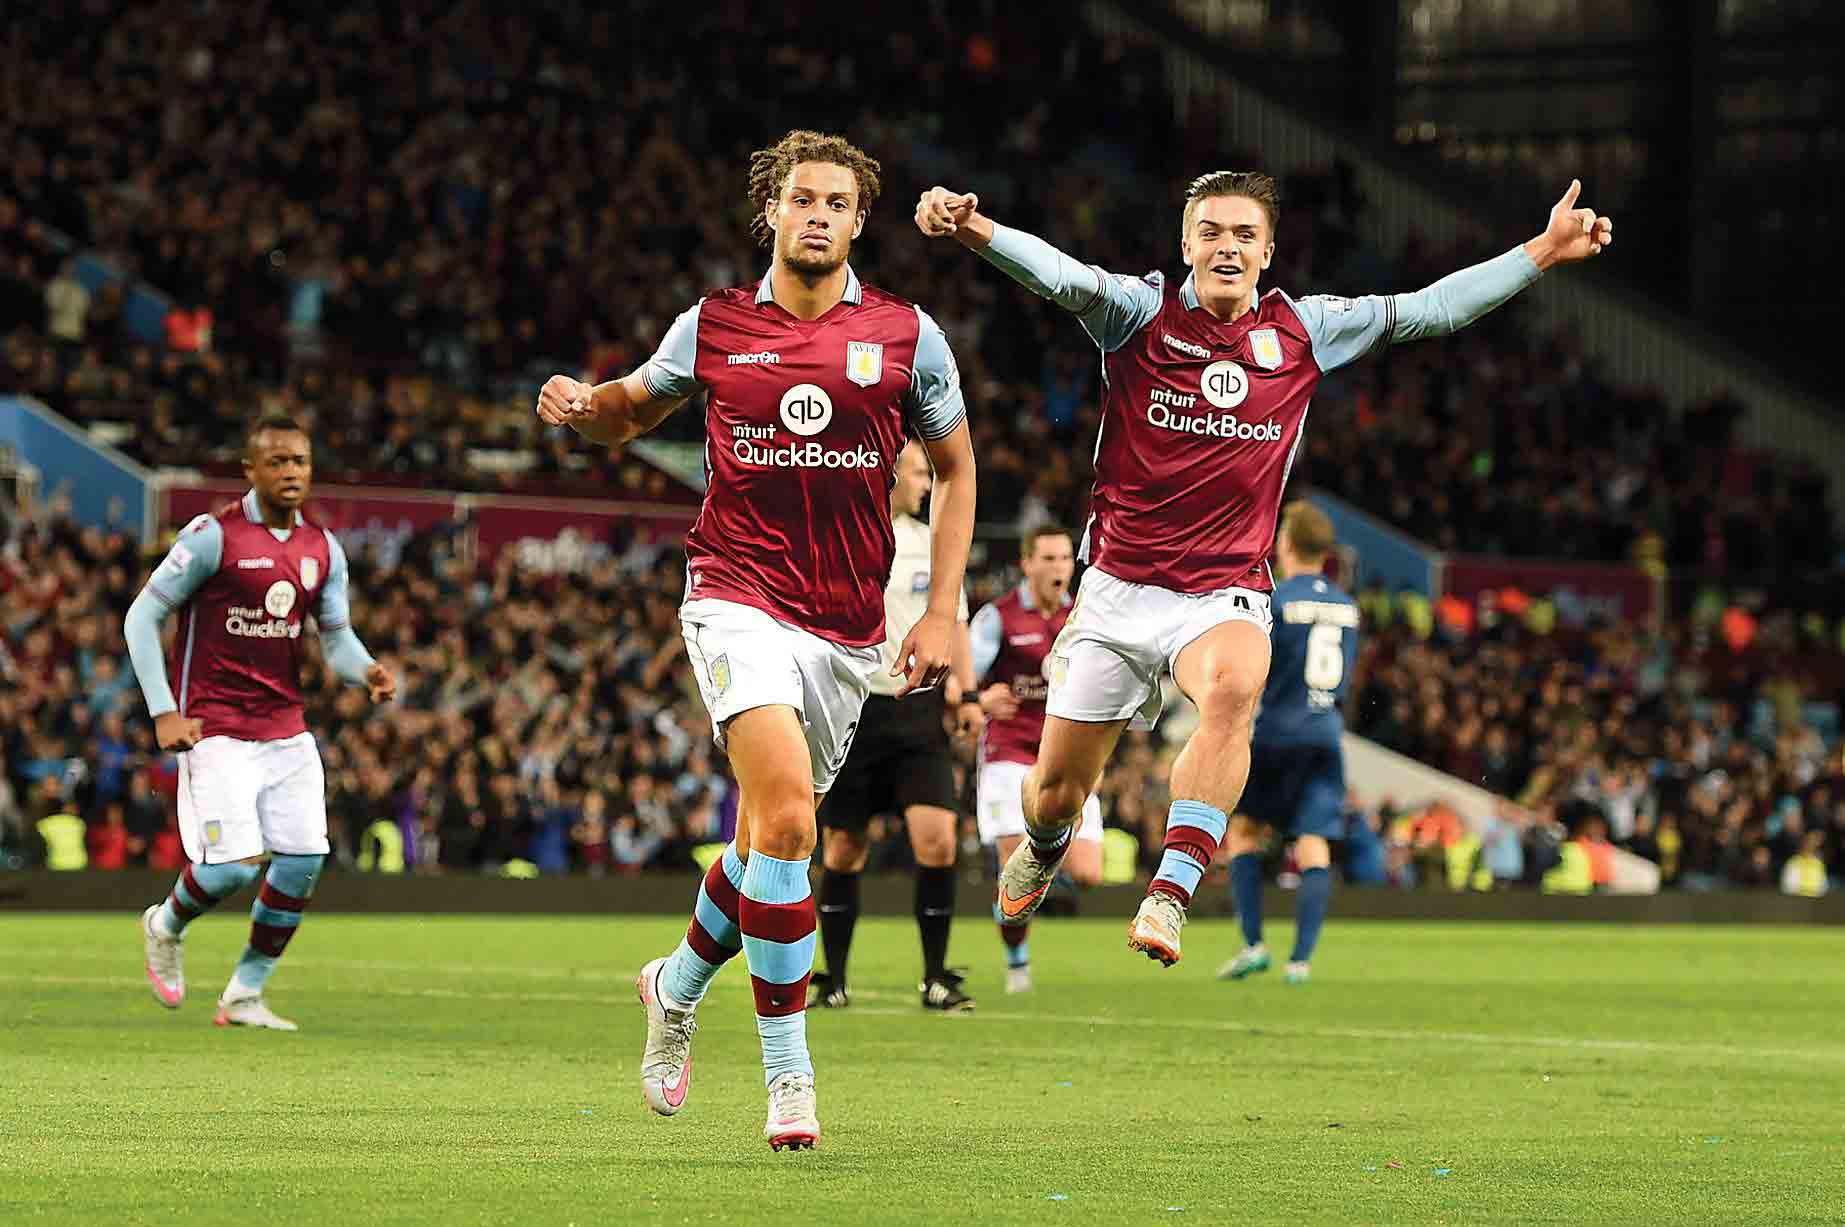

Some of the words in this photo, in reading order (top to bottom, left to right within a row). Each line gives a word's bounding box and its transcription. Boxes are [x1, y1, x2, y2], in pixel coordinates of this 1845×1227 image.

[1147, 402, 1282, 441] QuickBooks
[733, 438, 880, 469] QuickBooks
[1304, 623, 1344, 690] 6
